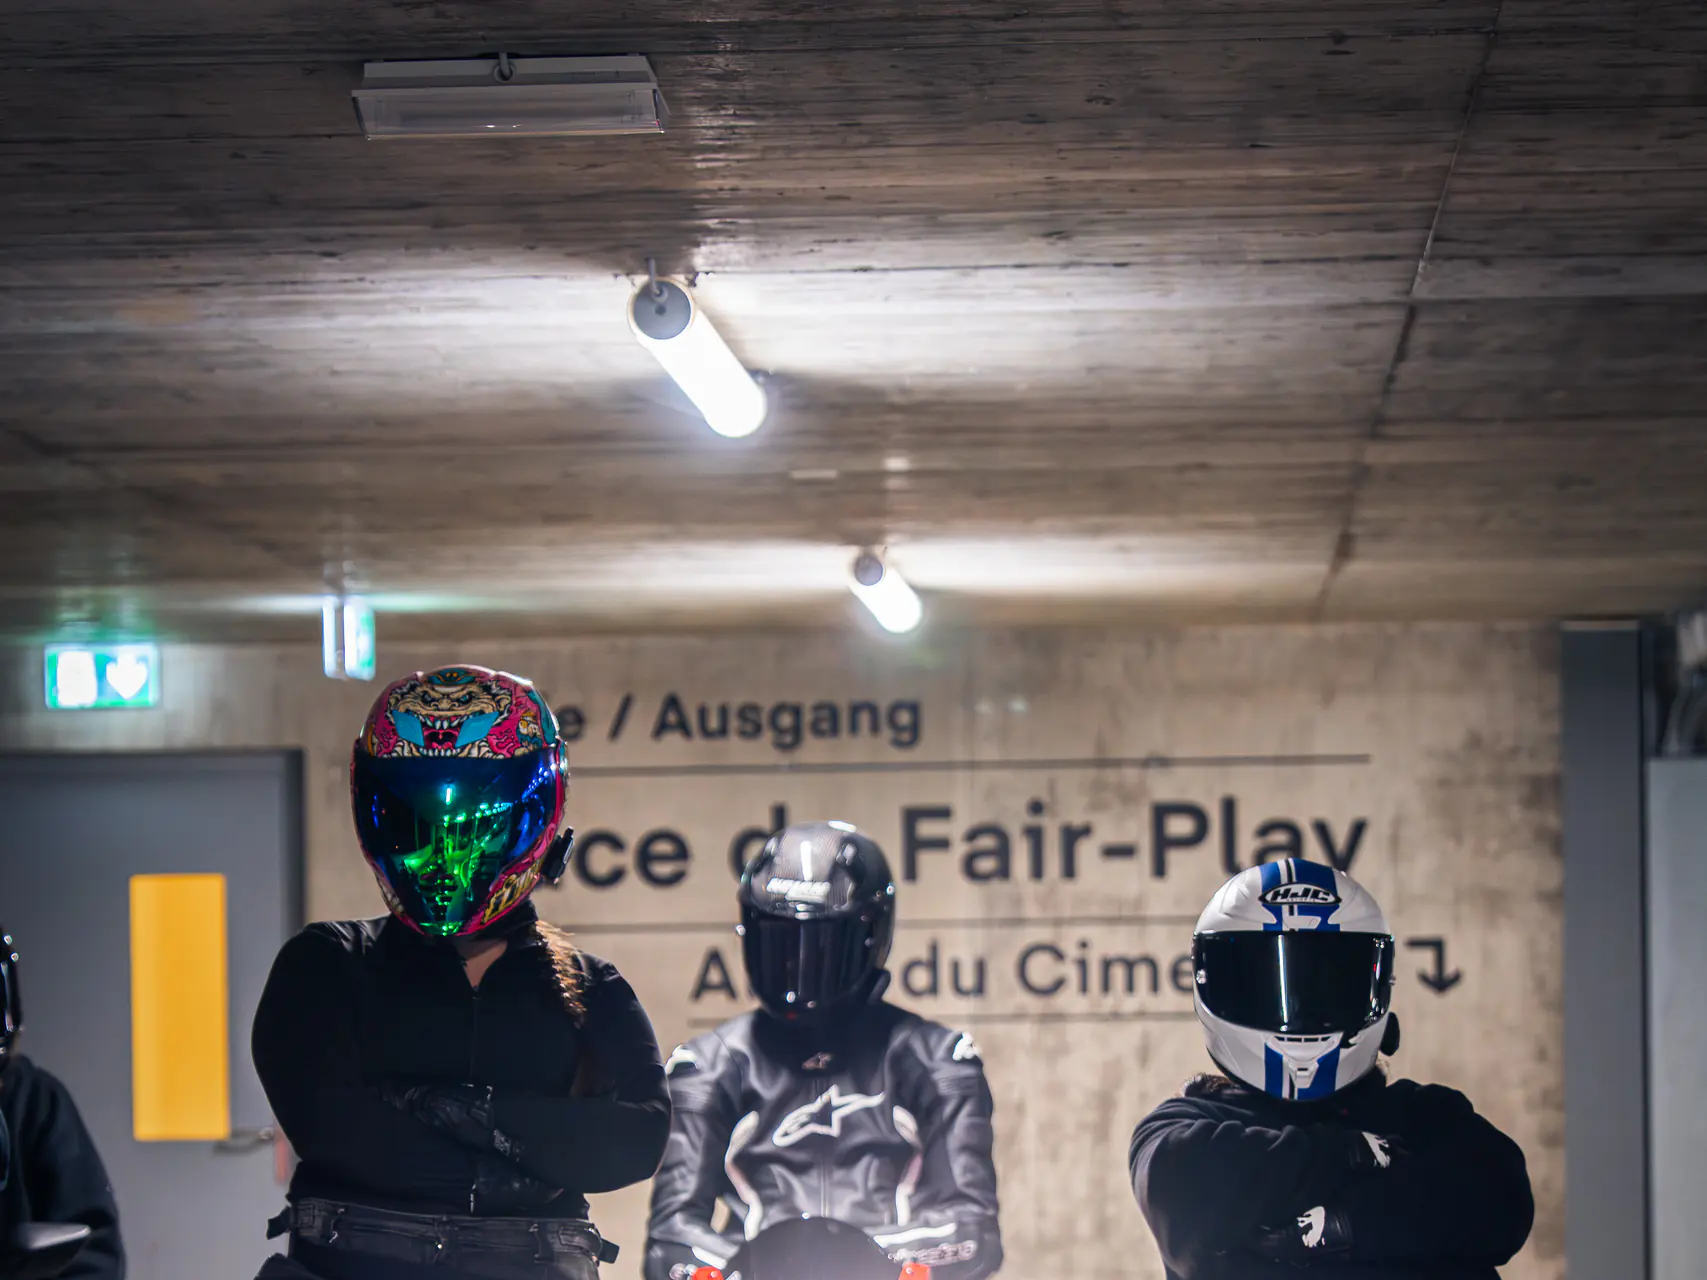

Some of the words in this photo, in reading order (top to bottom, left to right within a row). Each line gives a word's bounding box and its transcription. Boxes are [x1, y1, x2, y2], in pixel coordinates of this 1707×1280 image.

[652, 694, 921, 751] Ausgang
[902, 795, 1368, 882] Fair-Play
[1270, 887, 1331, 902] HJC
[902, 940, 986, 997] du
[1016, 941, 1194, 997] Cime
